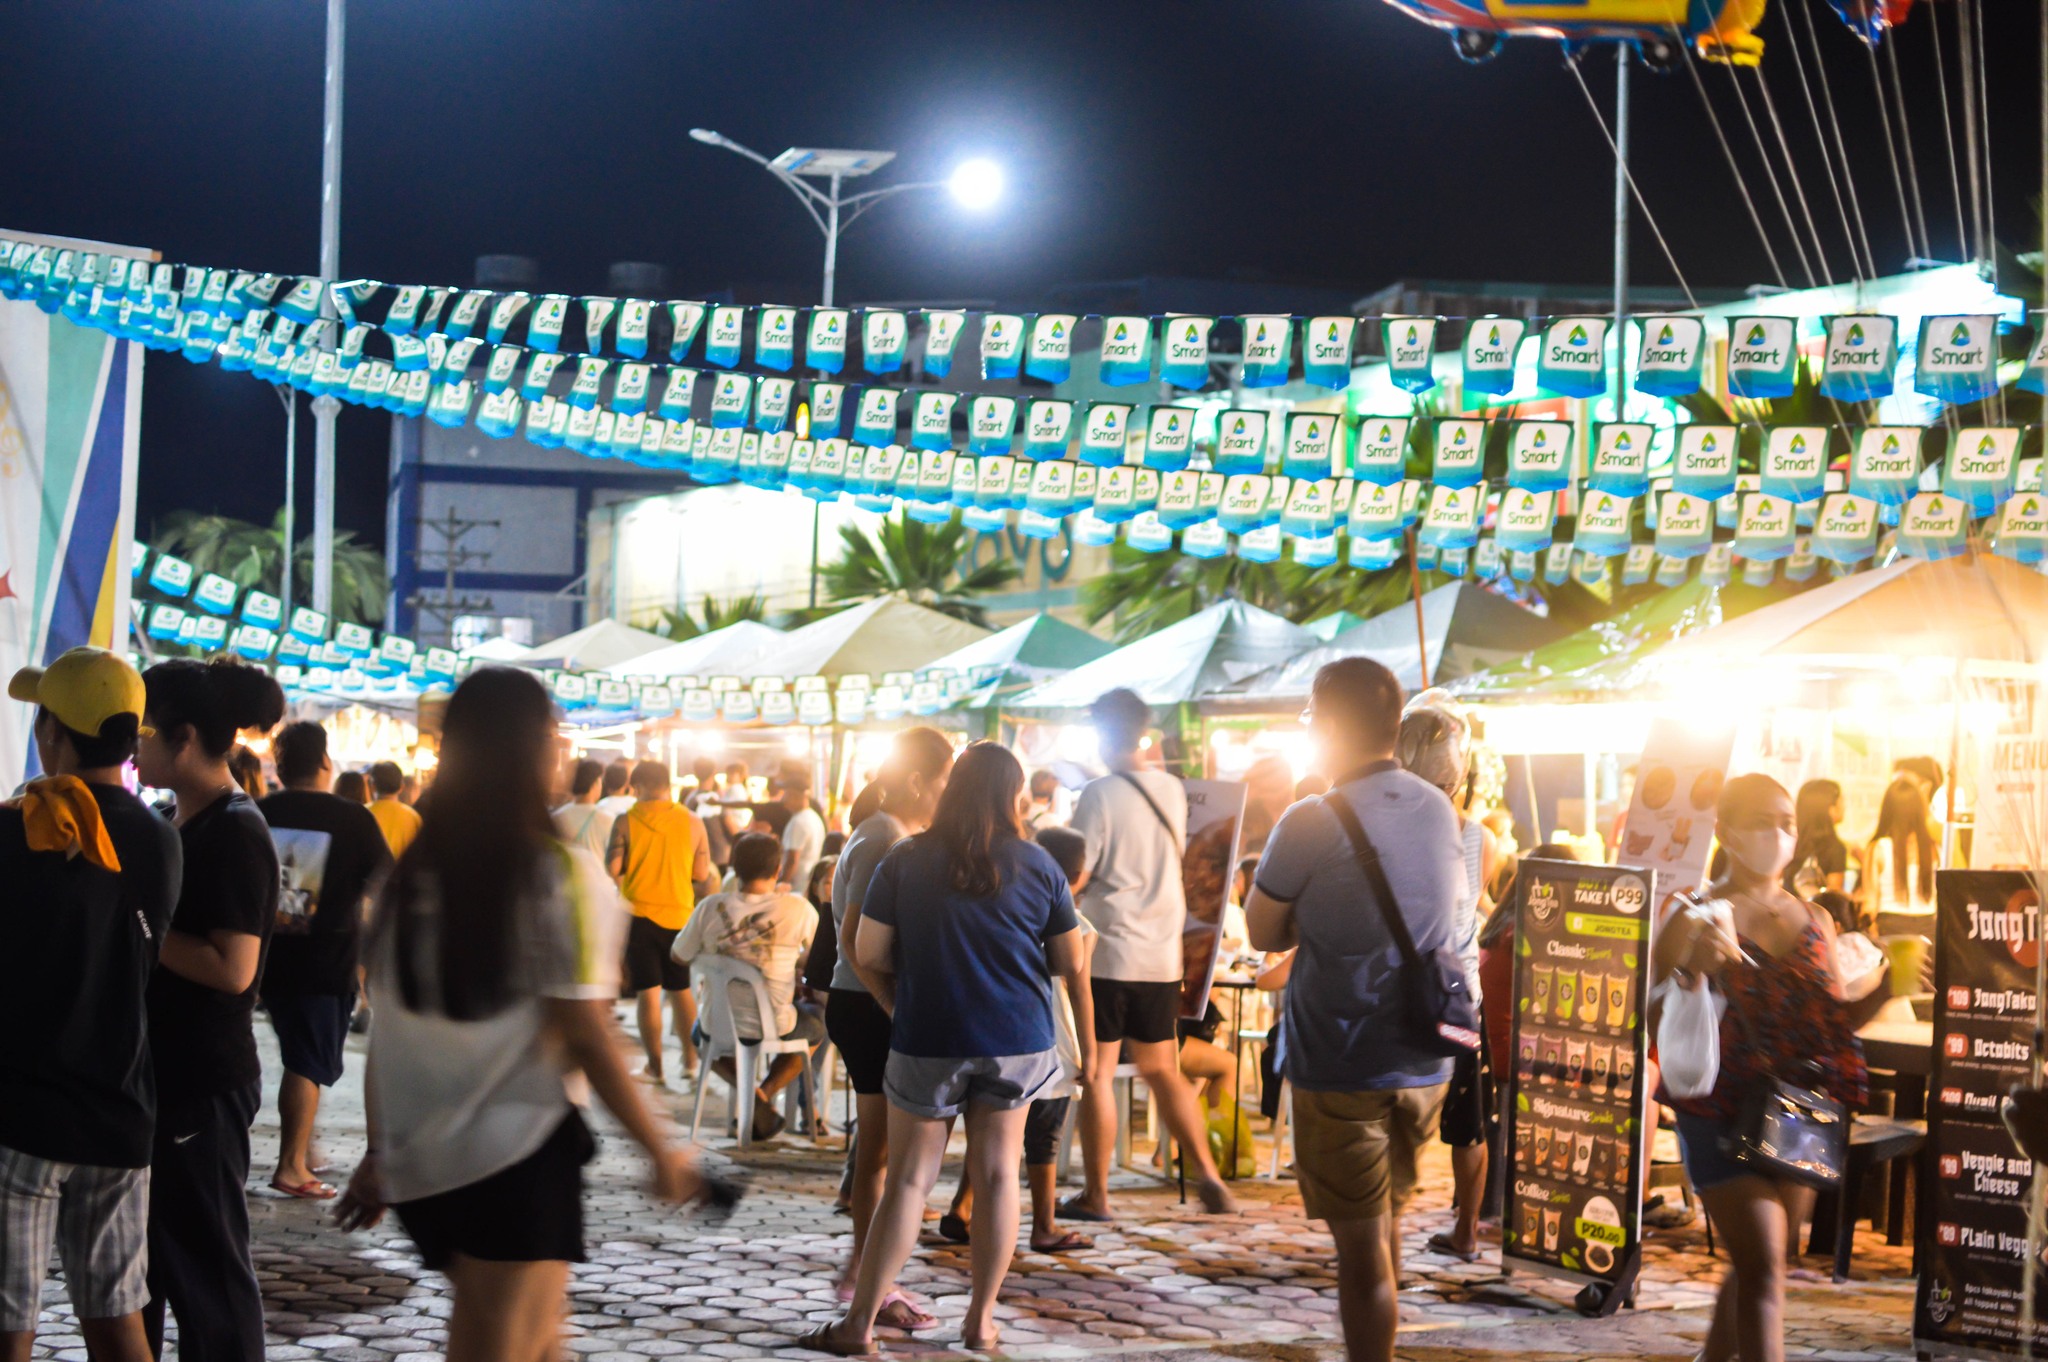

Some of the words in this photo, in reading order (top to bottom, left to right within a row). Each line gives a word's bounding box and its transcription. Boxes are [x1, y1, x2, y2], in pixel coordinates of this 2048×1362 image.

[1551, 346, 1600, 364] Smart
[1644, 347, 1688, 364] Smart
[1732, 347, 1780, 366] Smart
[1831, 348, 1880, 366] Smart
[1931, 346, 1985, 366] Smart
[1155, 432, 1185, 446] Smart
[1294, 441, 1326, 454] Smart
[1366, 444, 1399, 458] Smart
[1442, 447, 1475, 461] Smart
[1521, 449, 1557, 465] Smart
[1600, 452, 1641, 467] Smart
[1686, 453, 1729, 469] Smart
[1774, 455, 1817, 472] Smart
[1865, 455, 1913, 473] Smart
[1959, 456, 2007, 474] Smart
[1100, 485, 1127, 499] Smart
[1164, 490, 1191, 504] Smart
[1228, 495, 1257, 509] Smart
[1292, 500, 1328, 515] Smart
[1360, 501, 1393, 516] Smart
[1432, 510, 1469, 524] Smart
[1508, 511, 1543, 526] Smart
[1585, 513, 1624, 529] Smart
[1665, 517, 1700, 531] Smart
[1825, 517, 1867, 533] Smart
[1910, 517, 1953, 532] Smart
[1745, 519, 1783, 532] Smart
[1993, 741, 2048, 771] MENU
[1575, 889, 1603, 905] TAKE
[1604, 892, 1610, 906] 1
[1547, 940, 1587, 960] Classic
[1533, 1097, 1591, 1122] Signature
[1962, 1150, 2004, 1177] Veggie
[2007, 1158, 2032, 1177] and
[1515, 1180, 1550, 1200] Coffee
[1974, 1173, 2019, 1196] Cheese
